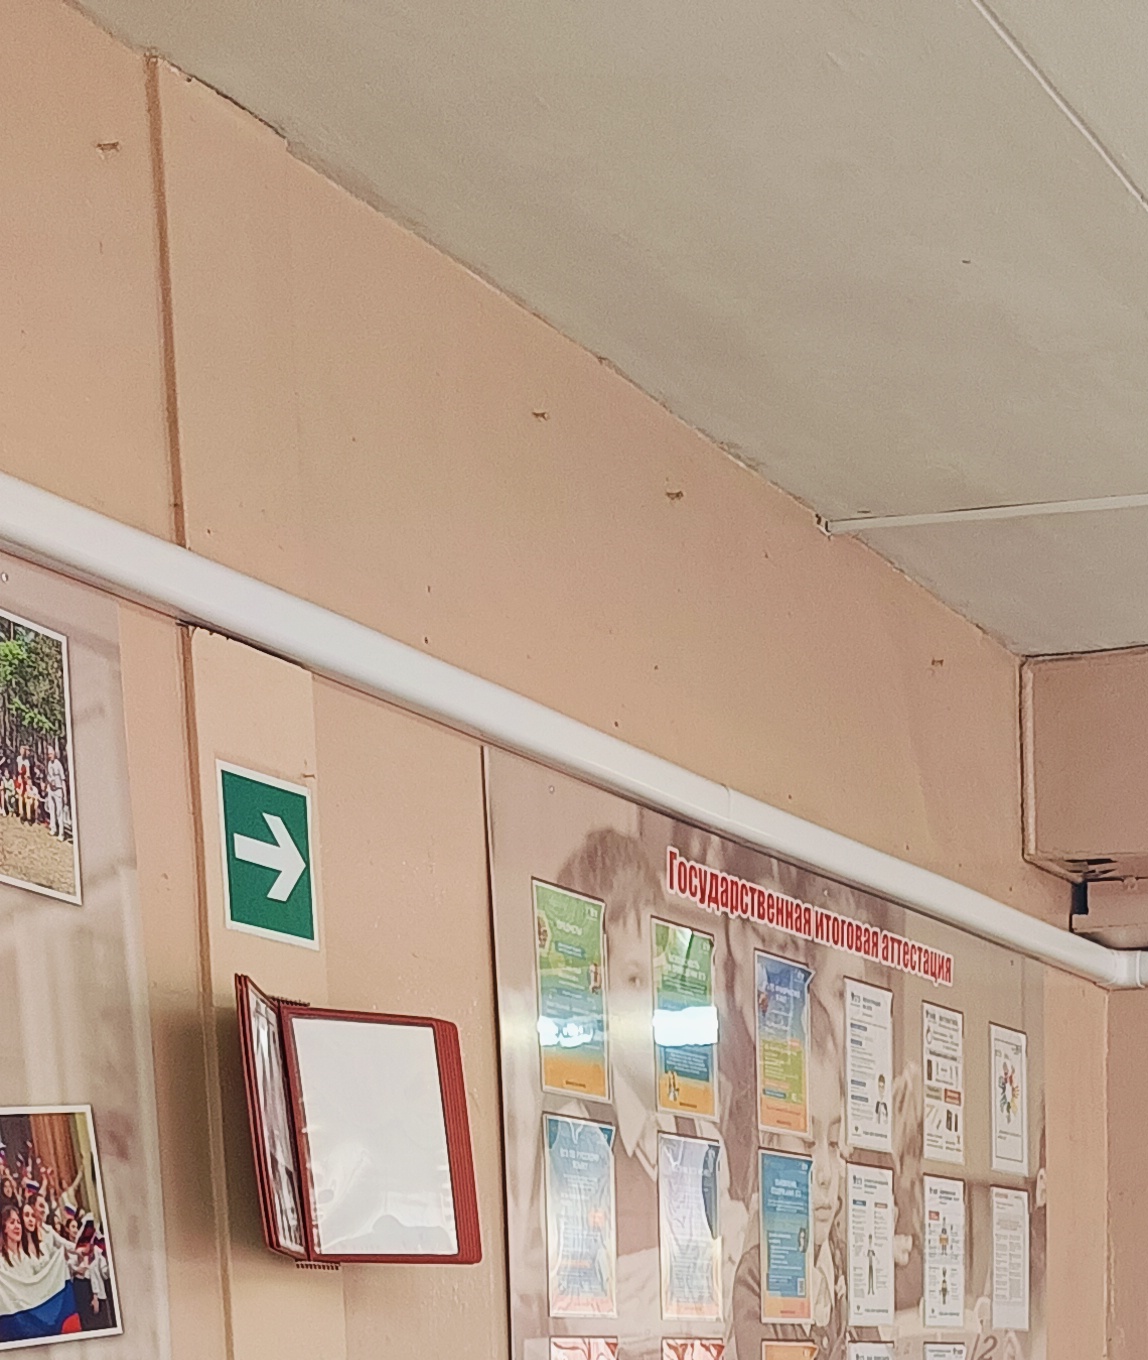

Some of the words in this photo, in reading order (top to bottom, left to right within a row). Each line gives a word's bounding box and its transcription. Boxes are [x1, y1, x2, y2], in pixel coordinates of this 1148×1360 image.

[668, 849, 812, 937] Государственная
[815, 909, 879, 962] итоговая
[881, 936, 952, 983] аттестация
